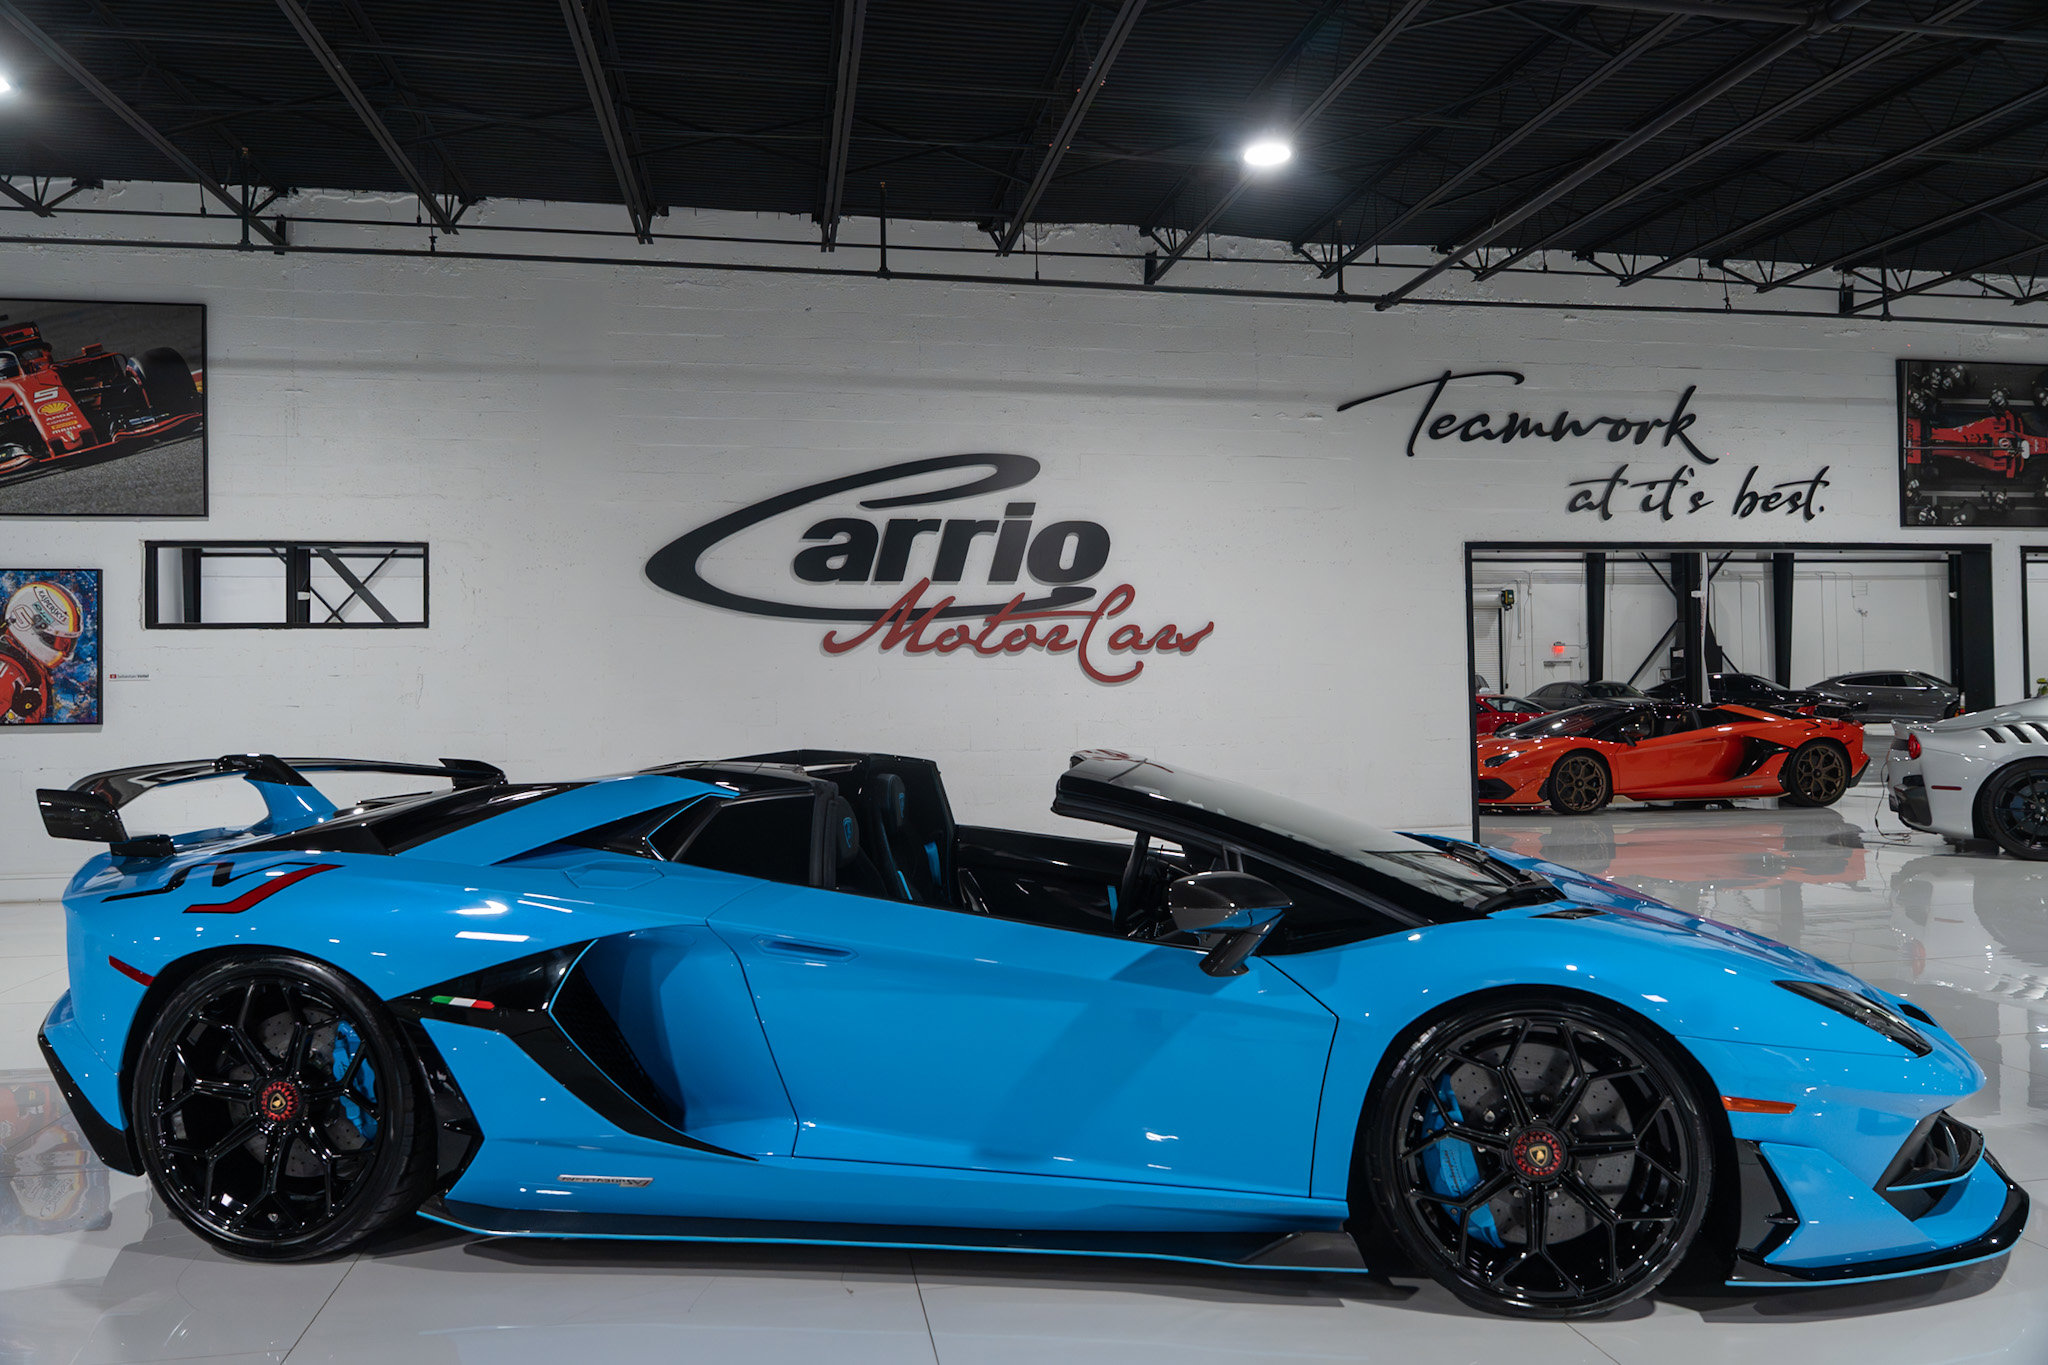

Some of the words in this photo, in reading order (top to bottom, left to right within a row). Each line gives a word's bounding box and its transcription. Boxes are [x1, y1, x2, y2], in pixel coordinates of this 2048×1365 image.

[33, 387, 58, 404] 5
[1338, 370, 1719, 465] Teamwork
[1568, 464, 1630, 521] at
[1630, 465, 1714, 521] it's
[1733, 466, 1830, 521] best.
[645, 453, 1111, 623] Carrio
